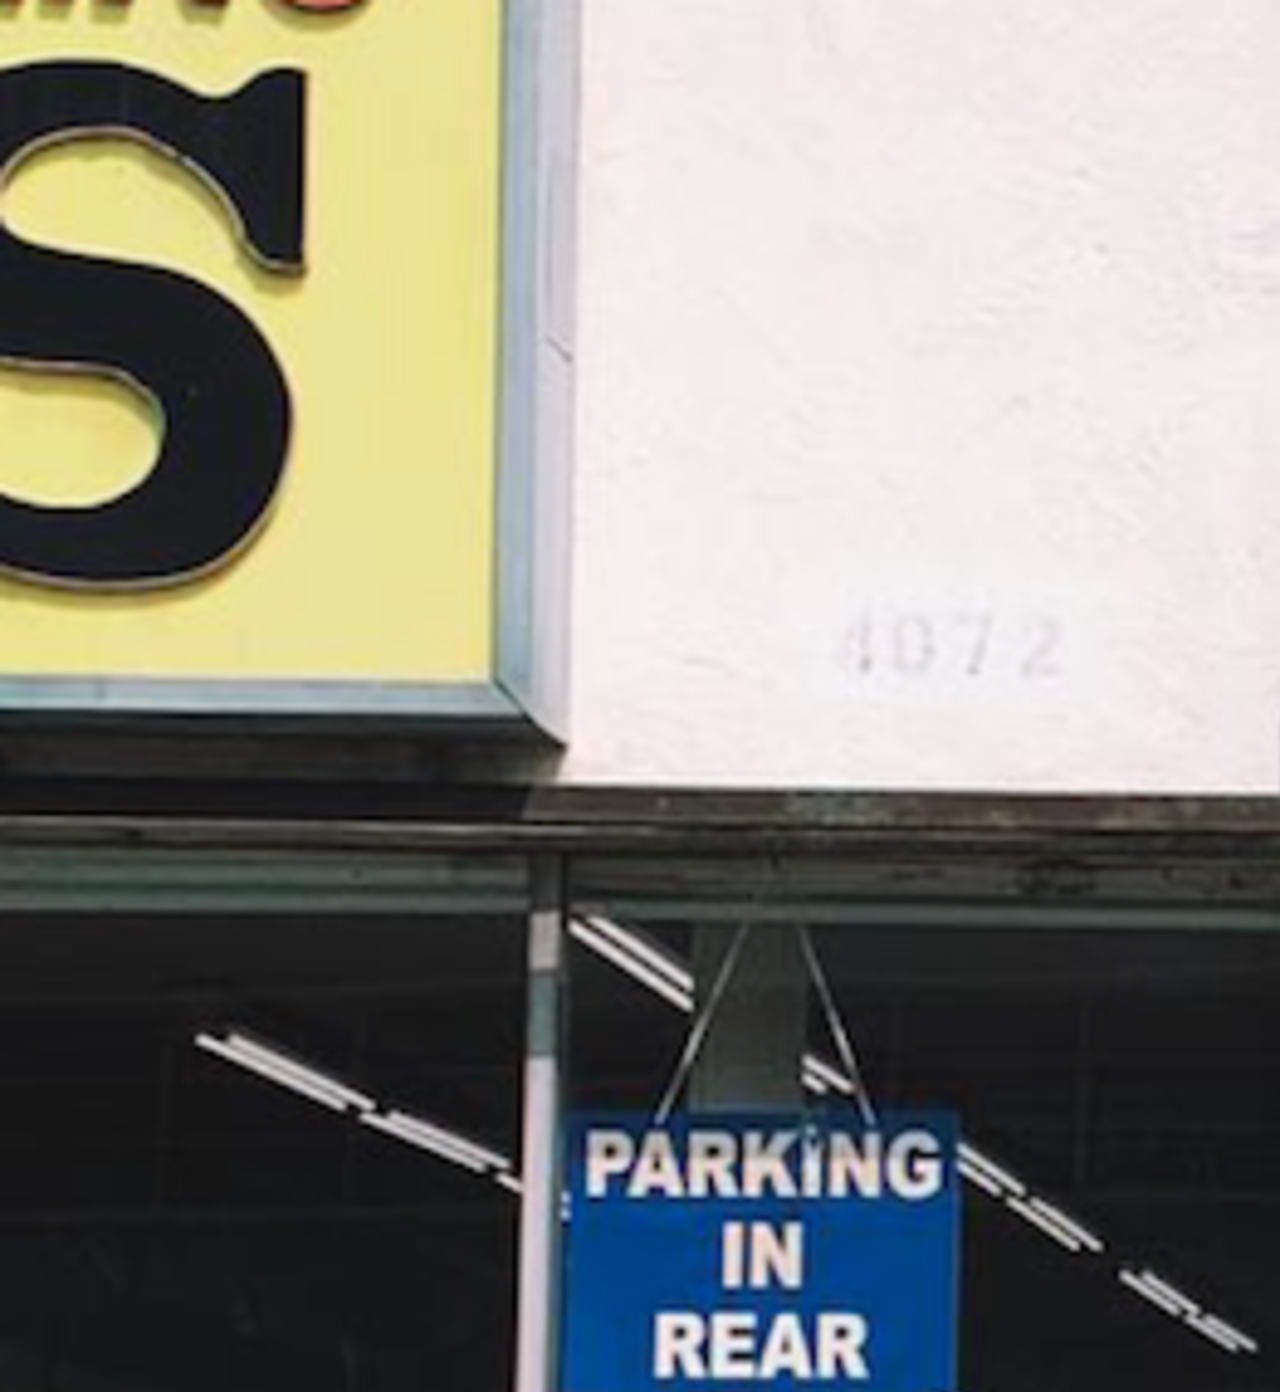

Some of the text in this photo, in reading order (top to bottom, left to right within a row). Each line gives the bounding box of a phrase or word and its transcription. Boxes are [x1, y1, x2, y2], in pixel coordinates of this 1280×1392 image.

[0, 59, 308, 590] S
[586, 1130, 942, 1199] PARKING
[722, 1221, 803, 1289] IN
[654, 1312, 868, 1380] REAR
